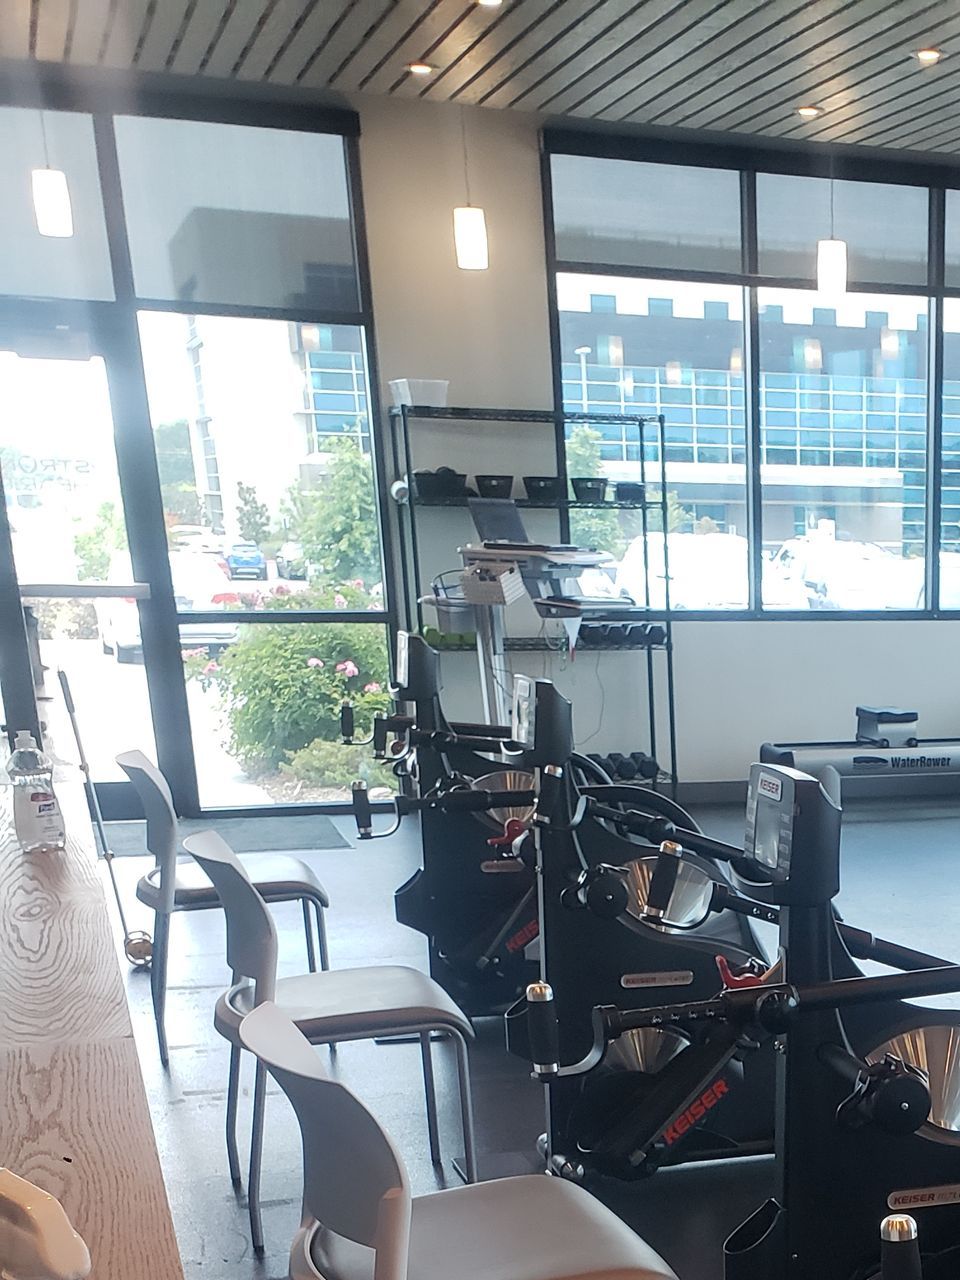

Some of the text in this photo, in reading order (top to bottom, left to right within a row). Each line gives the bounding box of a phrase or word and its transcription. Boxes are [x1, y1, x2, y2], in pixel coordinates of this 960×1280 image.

[891, 756, 951, 768] WaterRower
[663, 1079, 729, 1145] KEISER
[893, 1193, 935, 1205] KEISER
